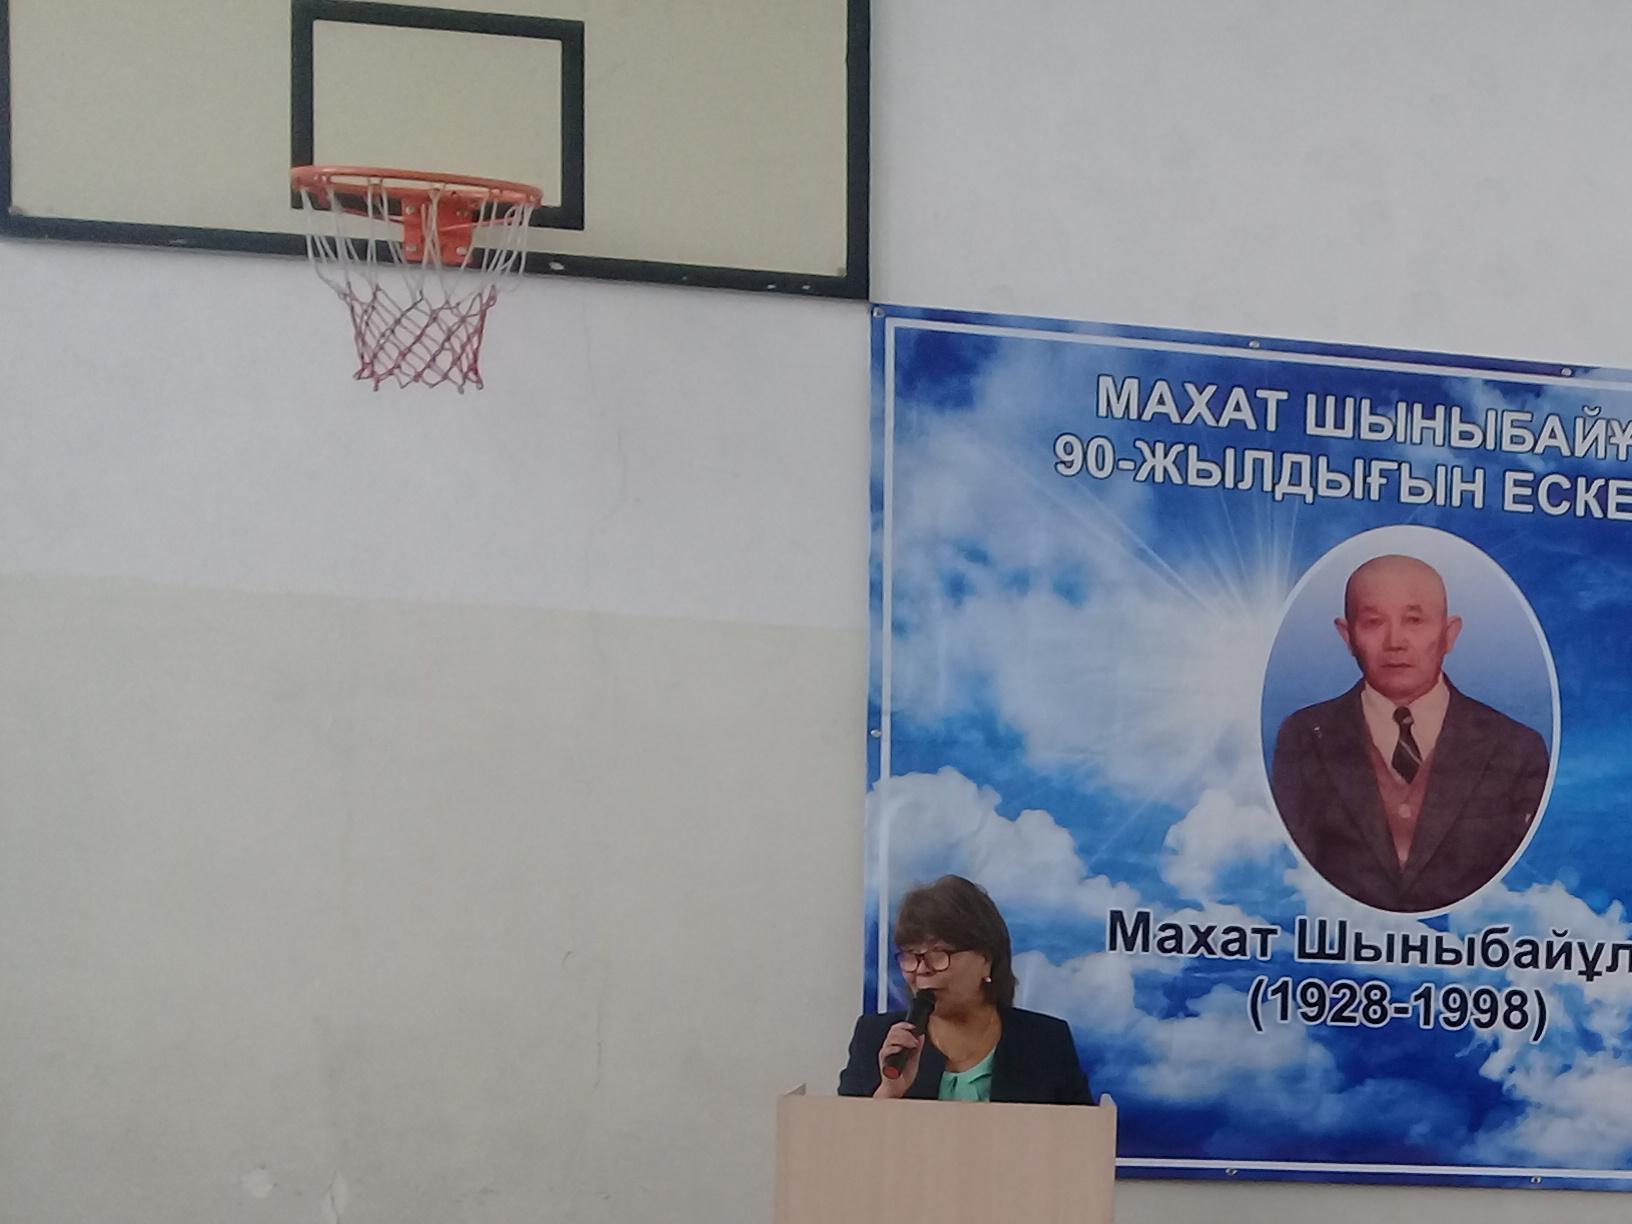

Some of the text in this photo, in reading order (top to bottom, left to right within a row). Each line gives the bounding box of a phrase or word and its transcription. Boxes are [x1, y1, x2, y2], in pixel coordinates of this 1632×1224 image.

[1097, 374, 1289, 431] МАХАТ
[1053, 433, 1487, 510] 90-ЖЫЛДЫҒЫН
[1107, 909, 1278, 960] Махат
[1248, 974, 1549, 1042] (1928-1998)
